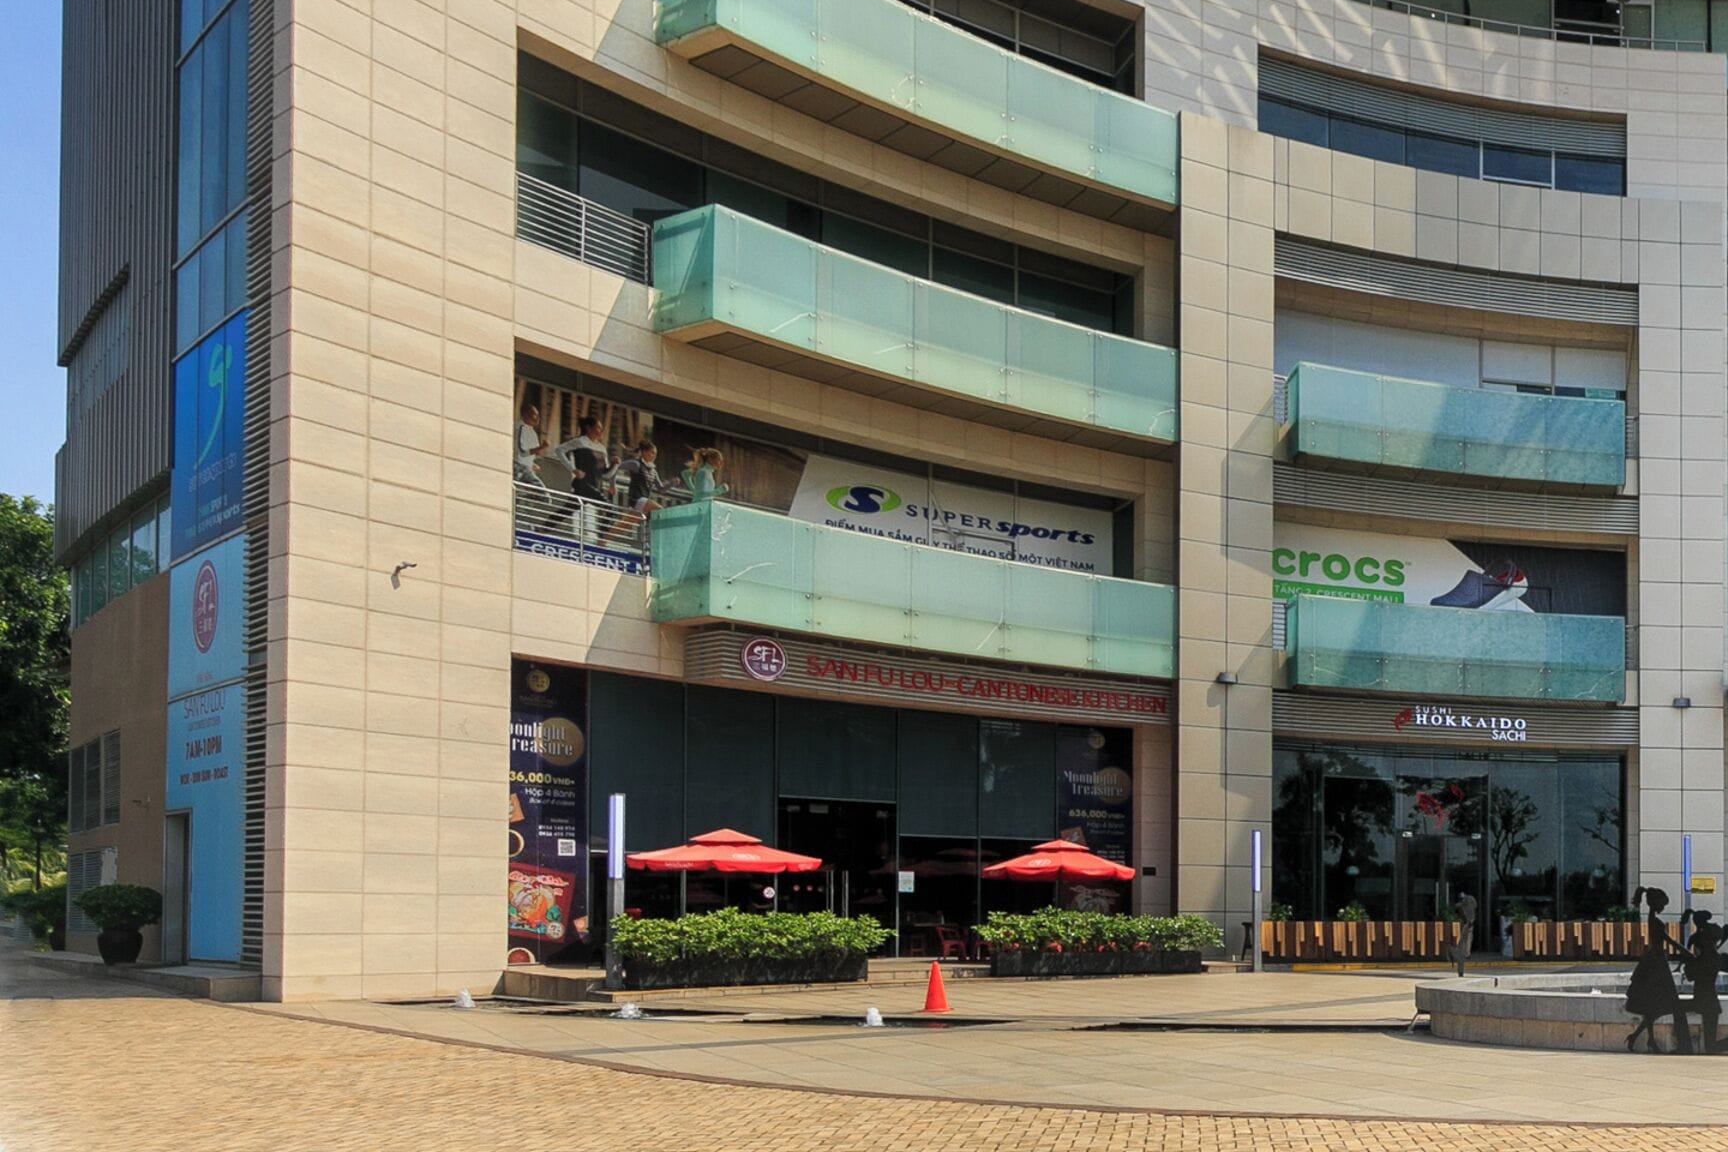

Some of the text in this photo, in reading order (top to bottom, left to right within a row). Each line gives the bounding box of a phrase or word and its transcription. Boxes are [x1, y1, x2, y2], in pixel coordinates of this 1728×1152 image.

[858, 525, 885, 537] MUA
[966, 546, 997, 559] THAO
[1070, 560, 1096, 572] NAM
[1272, 547, 1406, 587] crocs
[806, 655, 860, 683] SAN
[863, 664, 896, 687] FU
[1082, 688, 1167, 714] KITCHEN
[1415, 705, 1452, 715] SUSHI
[1415, 714, 1527, 730] HOKKAIDO
[1492, 729, 1527, 741] SACHI
